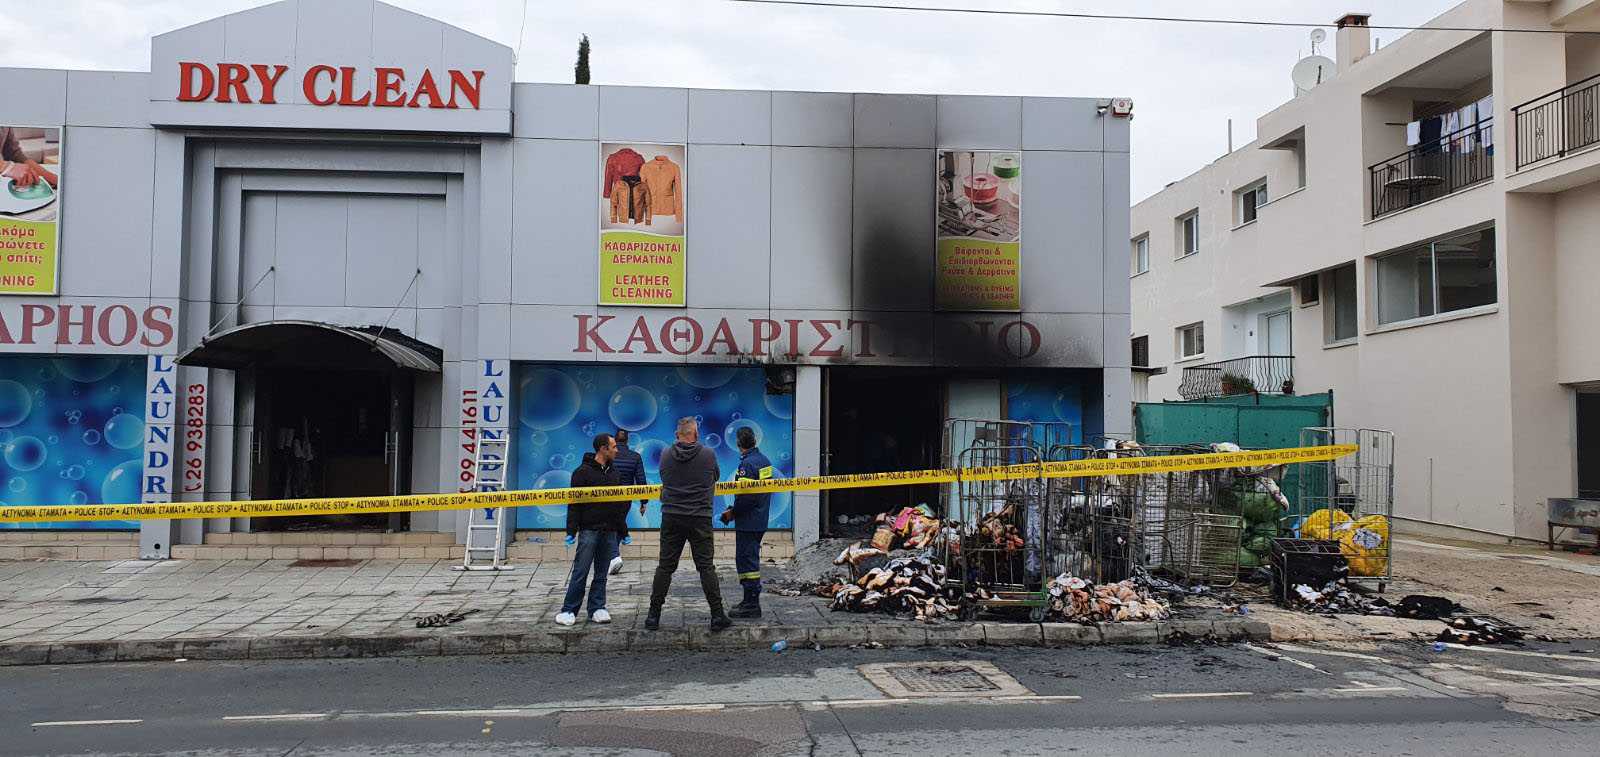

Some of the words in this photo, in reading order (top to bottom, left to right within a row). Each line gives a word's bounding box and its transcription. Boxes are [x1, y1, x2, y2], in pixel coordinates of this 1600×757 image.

[176, 62, 288, 105] DRY
[302, 65, 485, 110] CLEAN
[0, 224, 35, 238] κόμα
[605, 241, 681, 252] ΚΑΘΑΡΙΖΟΝΤΑΙ
[994, 246, 1001, 256] &
[613, 254, 673, 264] ΔΕΡΜΑΤΙΝΑ
[0, 275, 35, 286] NING
[616, 274, 669, 286] LEATHER
[612, 287, 673, 299] CLEANING
[572, 314, 1041, 359] ΚΑΘΑΡΙΣΤΙΟ
[146, 354, 173, 503] LAUNDR
[186, 383, 205, 451] 938283
[460, 390, 478, 482] 99441611
[185, 457, 203, 480] 26
[740, 480, 767, 489] ΣΤΑΜΑΤΑ
[774, 479, 794, 487] POLICE
[886, 472, 907, 480] POLICE
[931, 468, 964, 477] ΑΣΤΥΝΟΜΑ
[1024, 464, 1040, 473] STOP
[2, 509, 36, 517] ΑΣΤΥΝΟΜΙΑ
[39, 508, 67, 517] ΣΤΑΜΑΤΑ
[75, 508, 96, 516] POLICE
[99, 507, 115, 515] STOP
[122, 506, 156, 515] ΑΣΤΥΝΟΜΙΑ
[159, 506, 186, 514] ΣΤΑΜΑΤΑ
[194, 505, 215, 513] POLICE
[217, 504, 233, 513] STOP
[240, 503, 273, 512] ΑΣΤΥΝΟΜΙΑ
[276, 502, 303, 511] ΣΤΑΜΑΤΑ
[310, 502, 331, 510] POLICE
[334, 501, 350, 509] STOP
[357, 499, 390, 508] ΑΣΤΥΝΟΜΙΑ
[393, 498, 420, 507] ΣΤΑΜΑΤΑ
[428, 497, 449, 506] POLICE
[451, 497, 467, 505] STOP
[474, 494, 507, 503] ΑΣΤΥΝΟΜΙΑ
[510, 493, 537, 502] ΣΤΑΜΑΤΑ
[544, 491, 566, 500] POLICE
[568, 490, 584, 499] STOP
[590, 488, 624, 497] ΑΣΤΥΝΟΜΙΑ
[627, 487, 653, 495] ΣΤΑΜΑΤΑ
